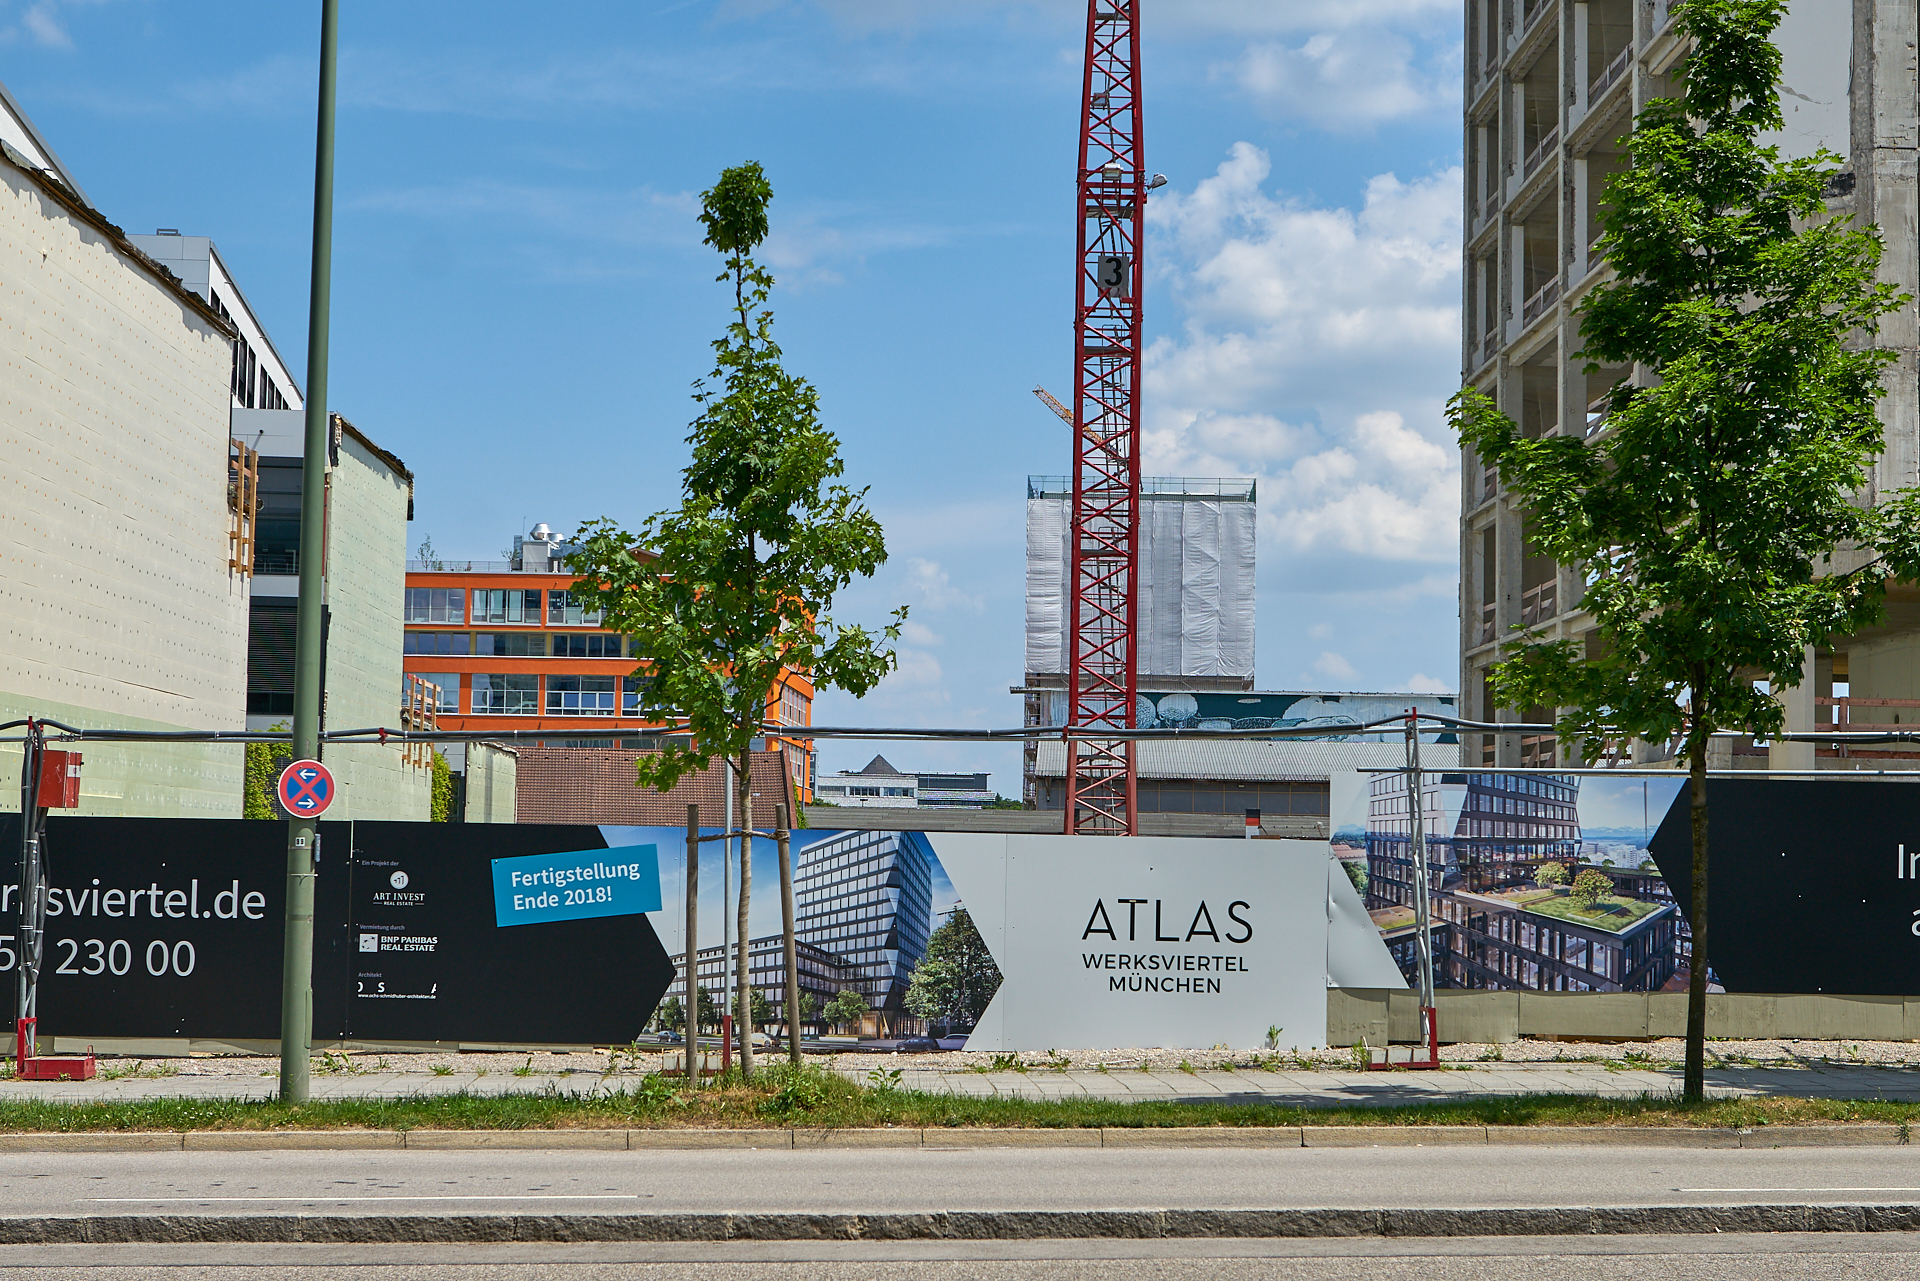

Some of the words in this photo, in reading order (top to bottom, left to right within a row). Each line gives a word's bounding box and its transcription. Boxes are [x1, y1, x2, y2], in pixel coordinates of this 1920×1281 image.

[1104, 257, 1123, 287] 3
[371, 860, 389, 868] Projekt
[511, 862, 641, 888] Fertigstellung
[1, 878, 266, 920] rsviertel.de
[373, 892, 391, 901] ART
[393, 892, 426, 902] INVEST
[513, 891, 559, 911] Ende
[563, 885, 612, 906] 2018!
[1081, 897, 1254, 945] ATLAS
[380, 935, 400, 944] BNP
[400, 936, 438, 944] PARIBAS
[380, 943, 404, 951] REAL
[404, 944, 436, 952] ESTATE
[55, 938, 132, 977] 230
[145, 939, 196, 978] 00
[1081, 953, 1250, 972] WERKSVIERTEL
[1109, 972, 1221, 995] MÜNCHEN
